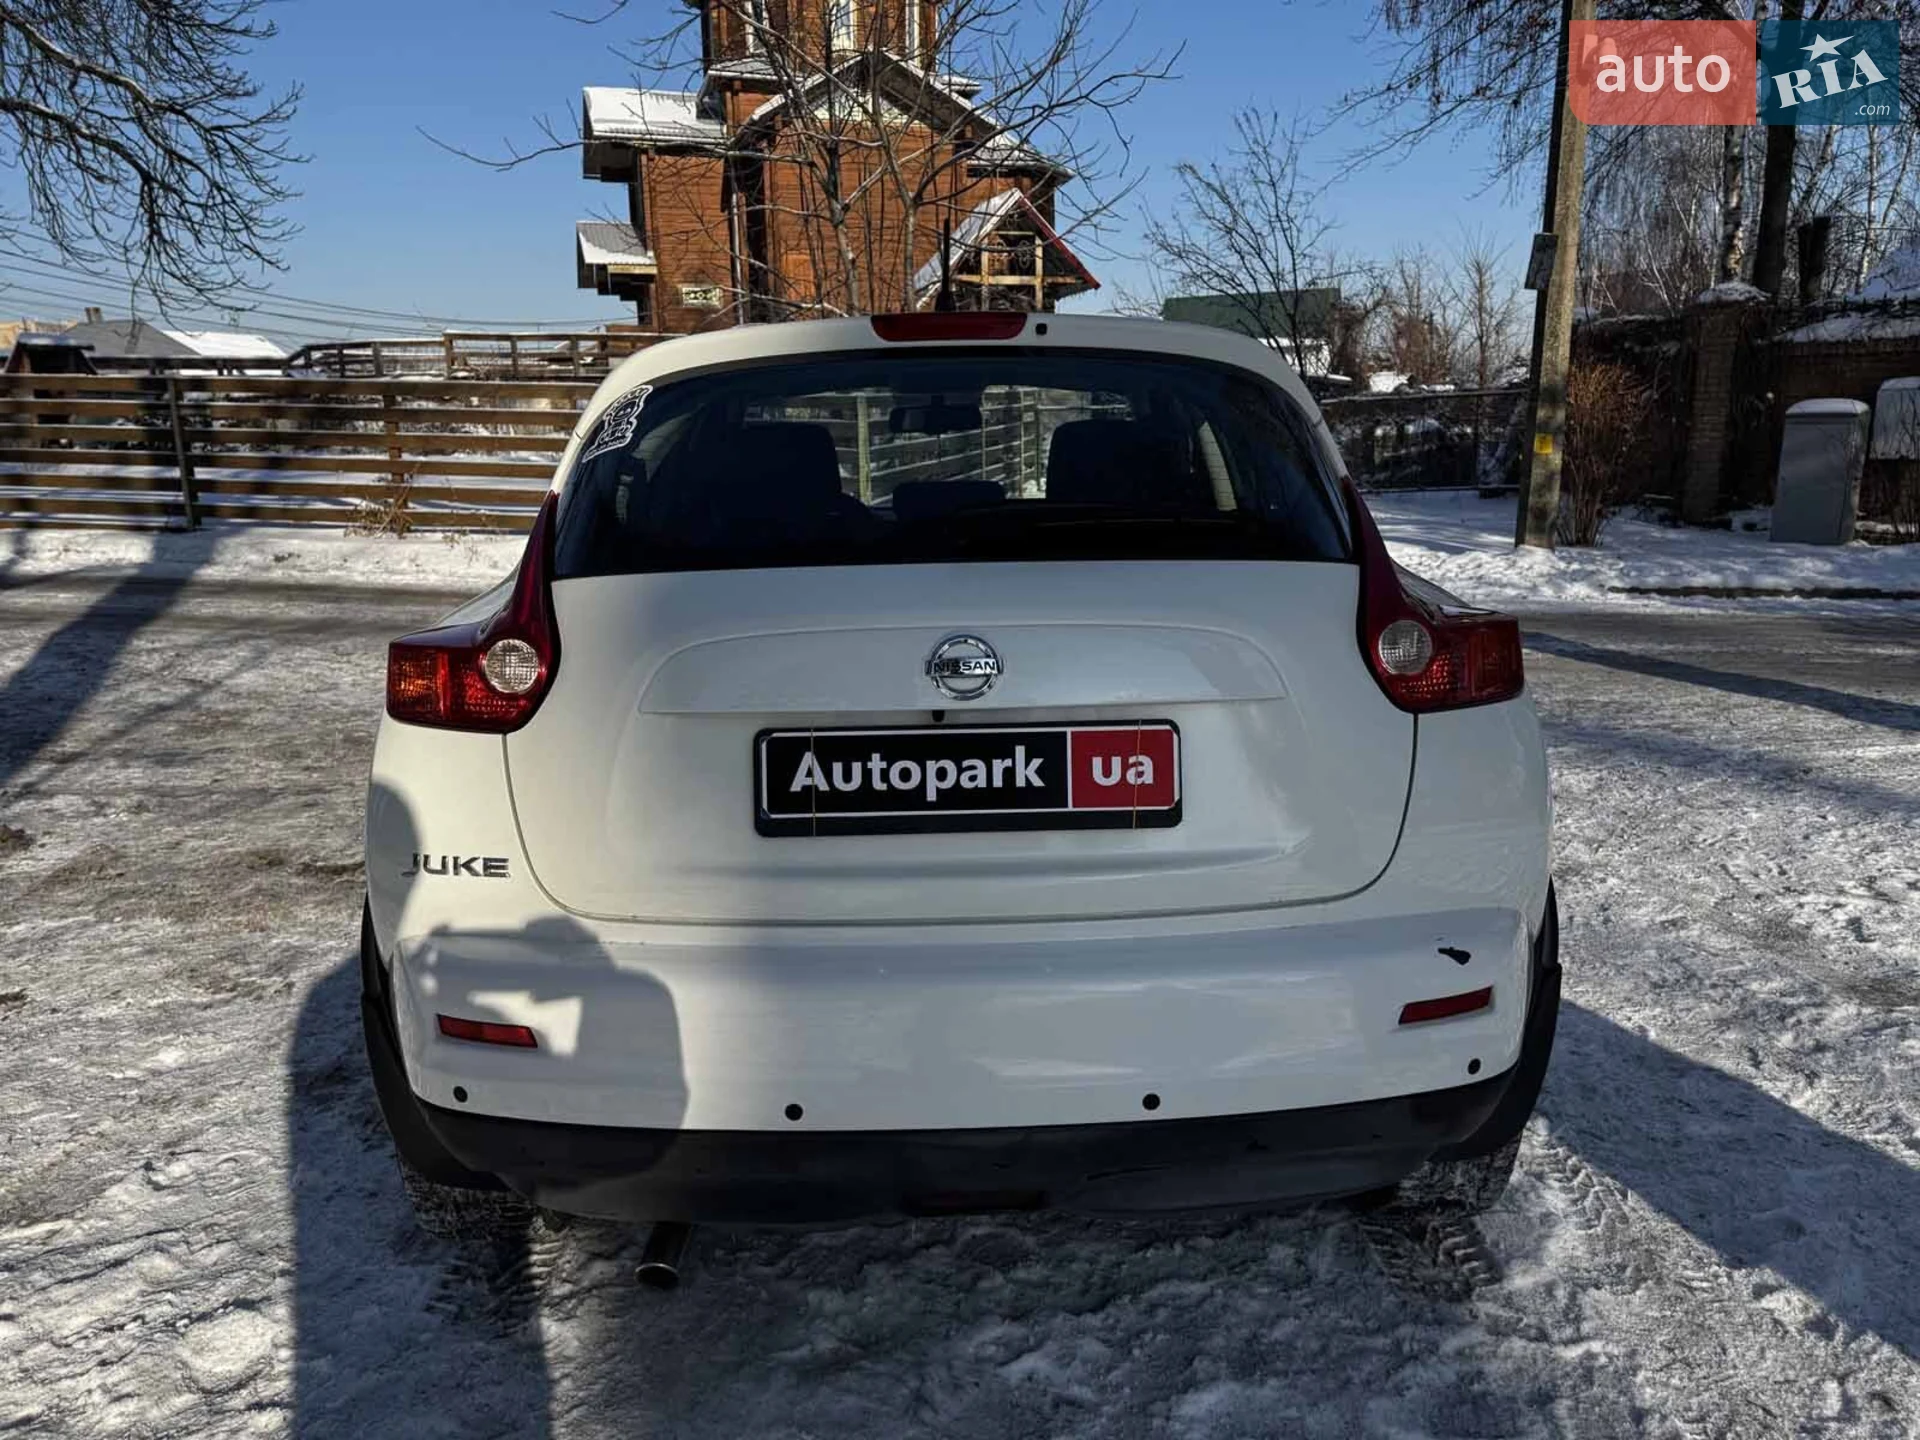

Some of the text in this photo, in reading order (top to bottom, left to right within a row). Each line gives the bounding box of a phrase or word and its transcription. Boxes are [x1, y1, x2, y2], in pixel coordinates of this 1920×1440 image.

[933, 660, 996, 673] NISSAN
[789, 745, 1154, 802] Autopark ua
[401, 852, 510, 878] JUKE
